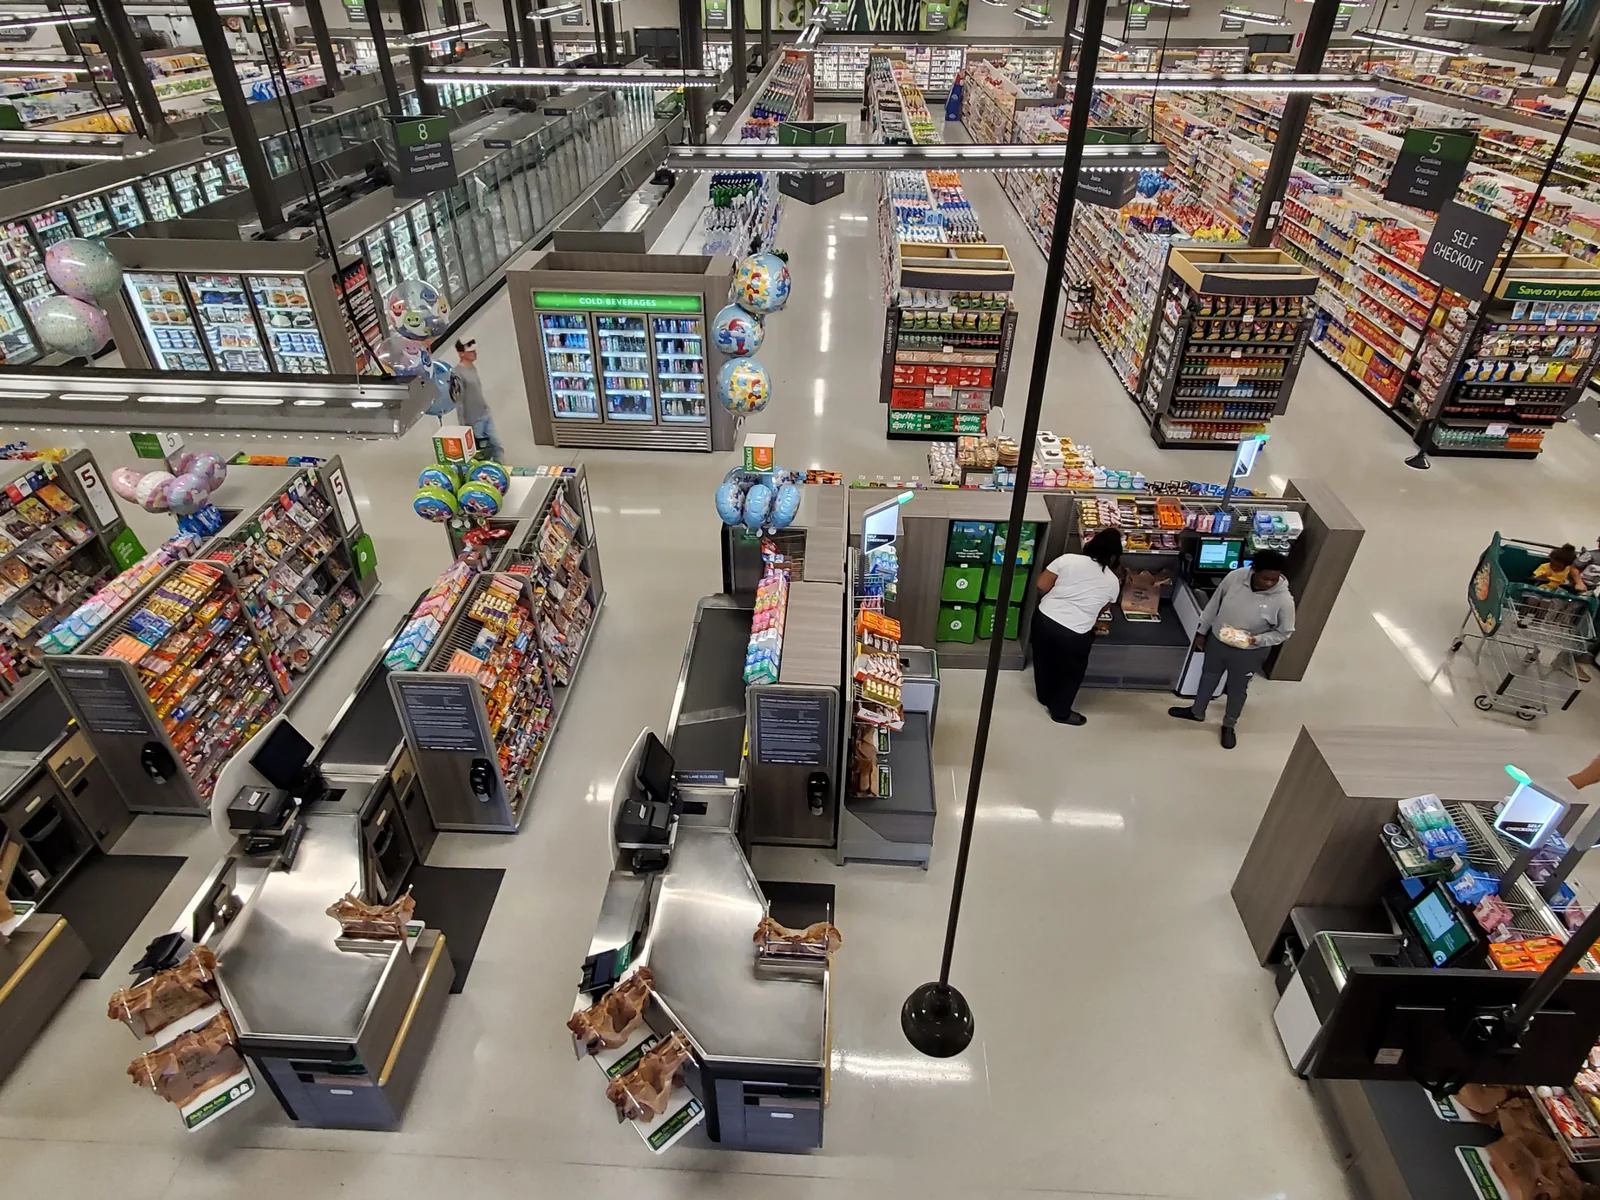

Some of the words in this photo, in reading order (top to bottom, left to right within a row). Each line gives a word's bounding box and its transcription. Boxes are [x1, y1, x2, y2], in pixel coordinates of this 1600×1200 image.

[418, 123, 429, 140] 8
[791, 129, 798, 145] 7
[828, 129, 835, 145] 7
[1428, 135, 1444, 154] 5
[1419, 155, 1442, 166] Cookies
[1090, 174, 1101, 182] Juice
[1414, 165, 1439, 176] Crackers
[1077, 181, 1098, 192] Powdered
[1098, 186, 1112, 196] Drinks
[1415, 177, 1430, 186] Nuts
[1408, 186, 1428, 197] Snacks
[1451, 229, 1478, 250] SELF
[1432, 241, 1485, 275] CHECKOUT
[1517, 285, 1543, 296] Save
[1543, 289, 1557, 297] on
[1556, 289, 1581, 299] your
[579, 297, 603, 305] COLD
[606, 298, 657, 307] BEVERAGES
[885, 319, 894, 354] GUARANTEED
[1004, 322, 1014, 351] CARRYOUT
[1173, 327, 1184, 356] CHECKOUT
[1292, 329, 1309, 366] GUARANTEED
[1455, 332, 1471, 360] CARRYOUT
[1000, 351, 1010, 372] SERVICE
[1166, 357, 1177, 380] PROMISE
[1445, 361, 1459, 383] SERVICE
[1576, 365, 1594, 389] PROMISE
[892, 411, 916, 421] Sprite
[961, 415, 981, 423] Sprite
[892, 421, 916, 430] Sprite
[960, 424, 979, 432] Sprite
[166, 432, 176, 448] 5
[434, 438, 446, 462] EXPRESS
[745, 447, 753, 471] EXPRESS
[81, 468, 96, 489] 5
[334, 475, 344, 495] 5
